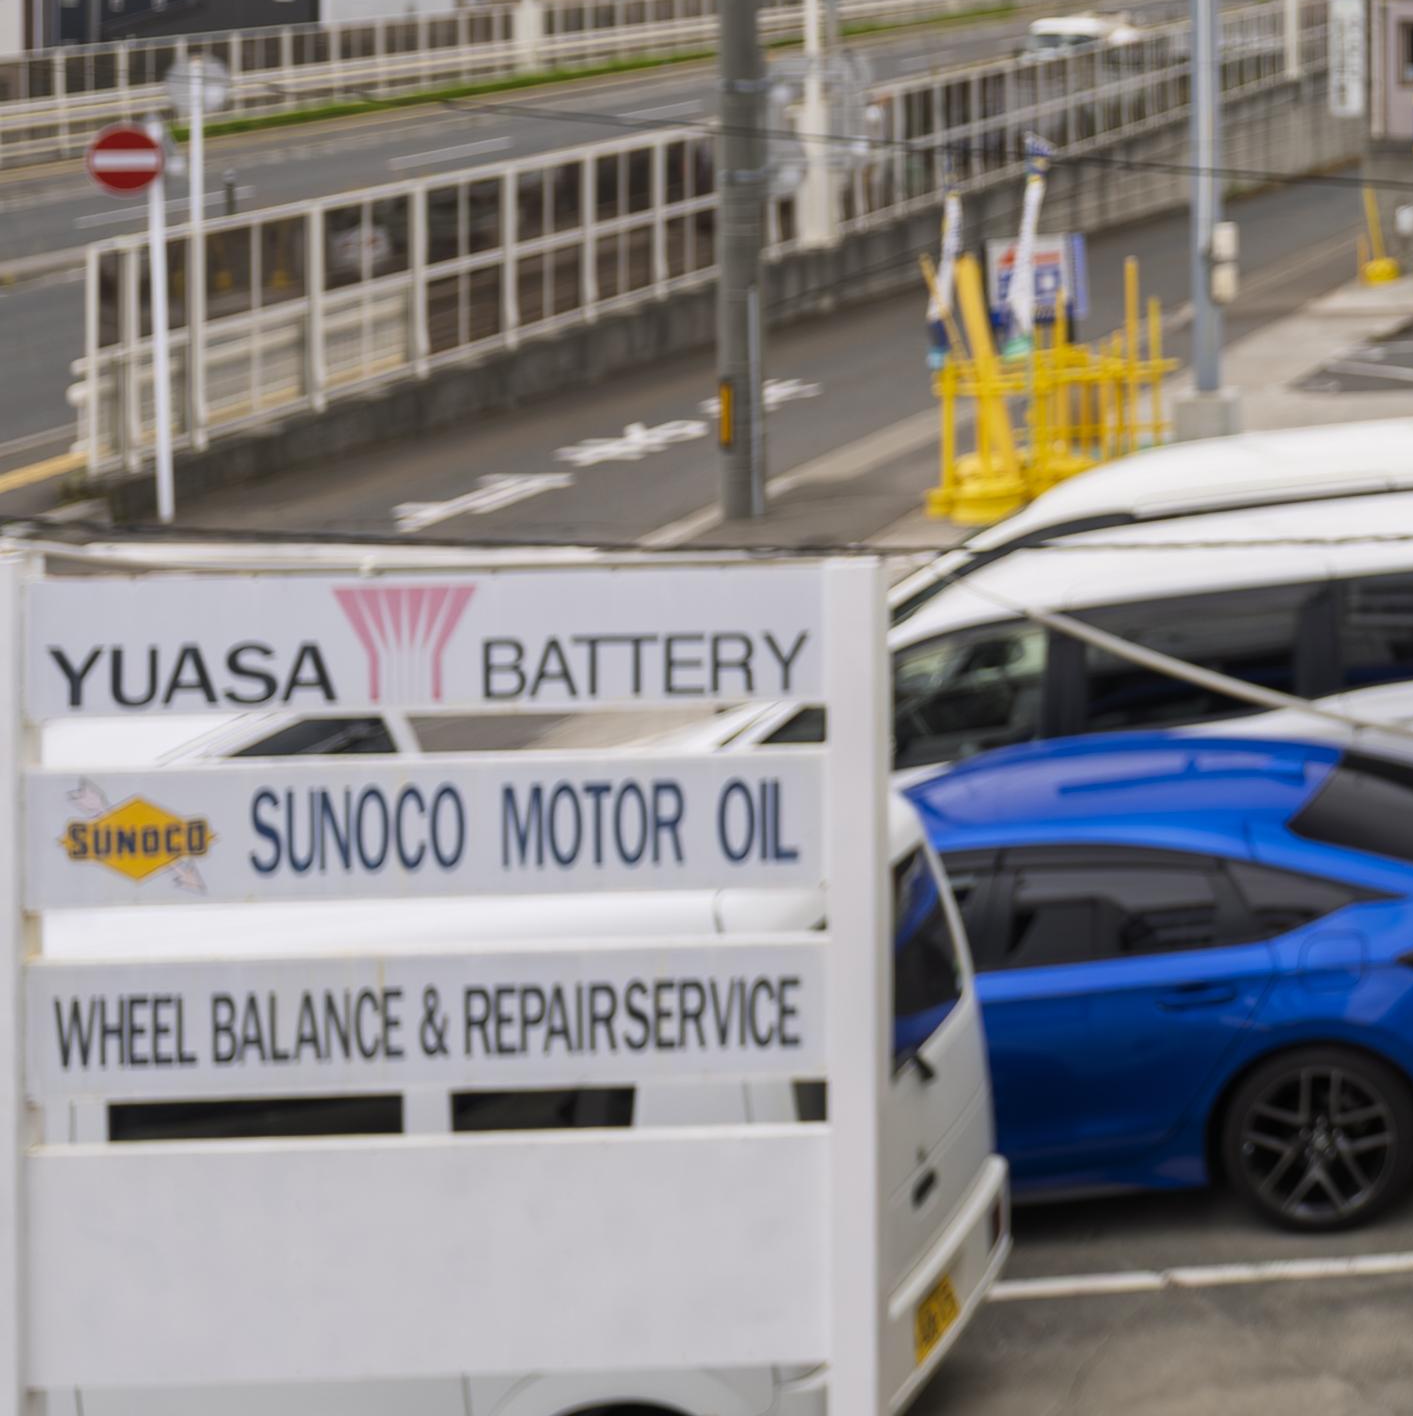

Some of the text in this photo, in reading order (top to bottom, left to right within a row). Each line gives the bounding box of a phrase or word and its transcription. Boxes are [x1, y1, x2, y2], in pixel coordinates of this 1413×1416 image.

[47, 629, 810, 708] YUASA BATTERY
[66, 819, 210, 861] SUNOCO
[250, 777, 800, 875] SUNOCO MOTOR OIL
[53, 993, 198, 1070] WHEEL
[210, 986, 405, 1065] BALANCE
[419, 984, 449, 1058] &
